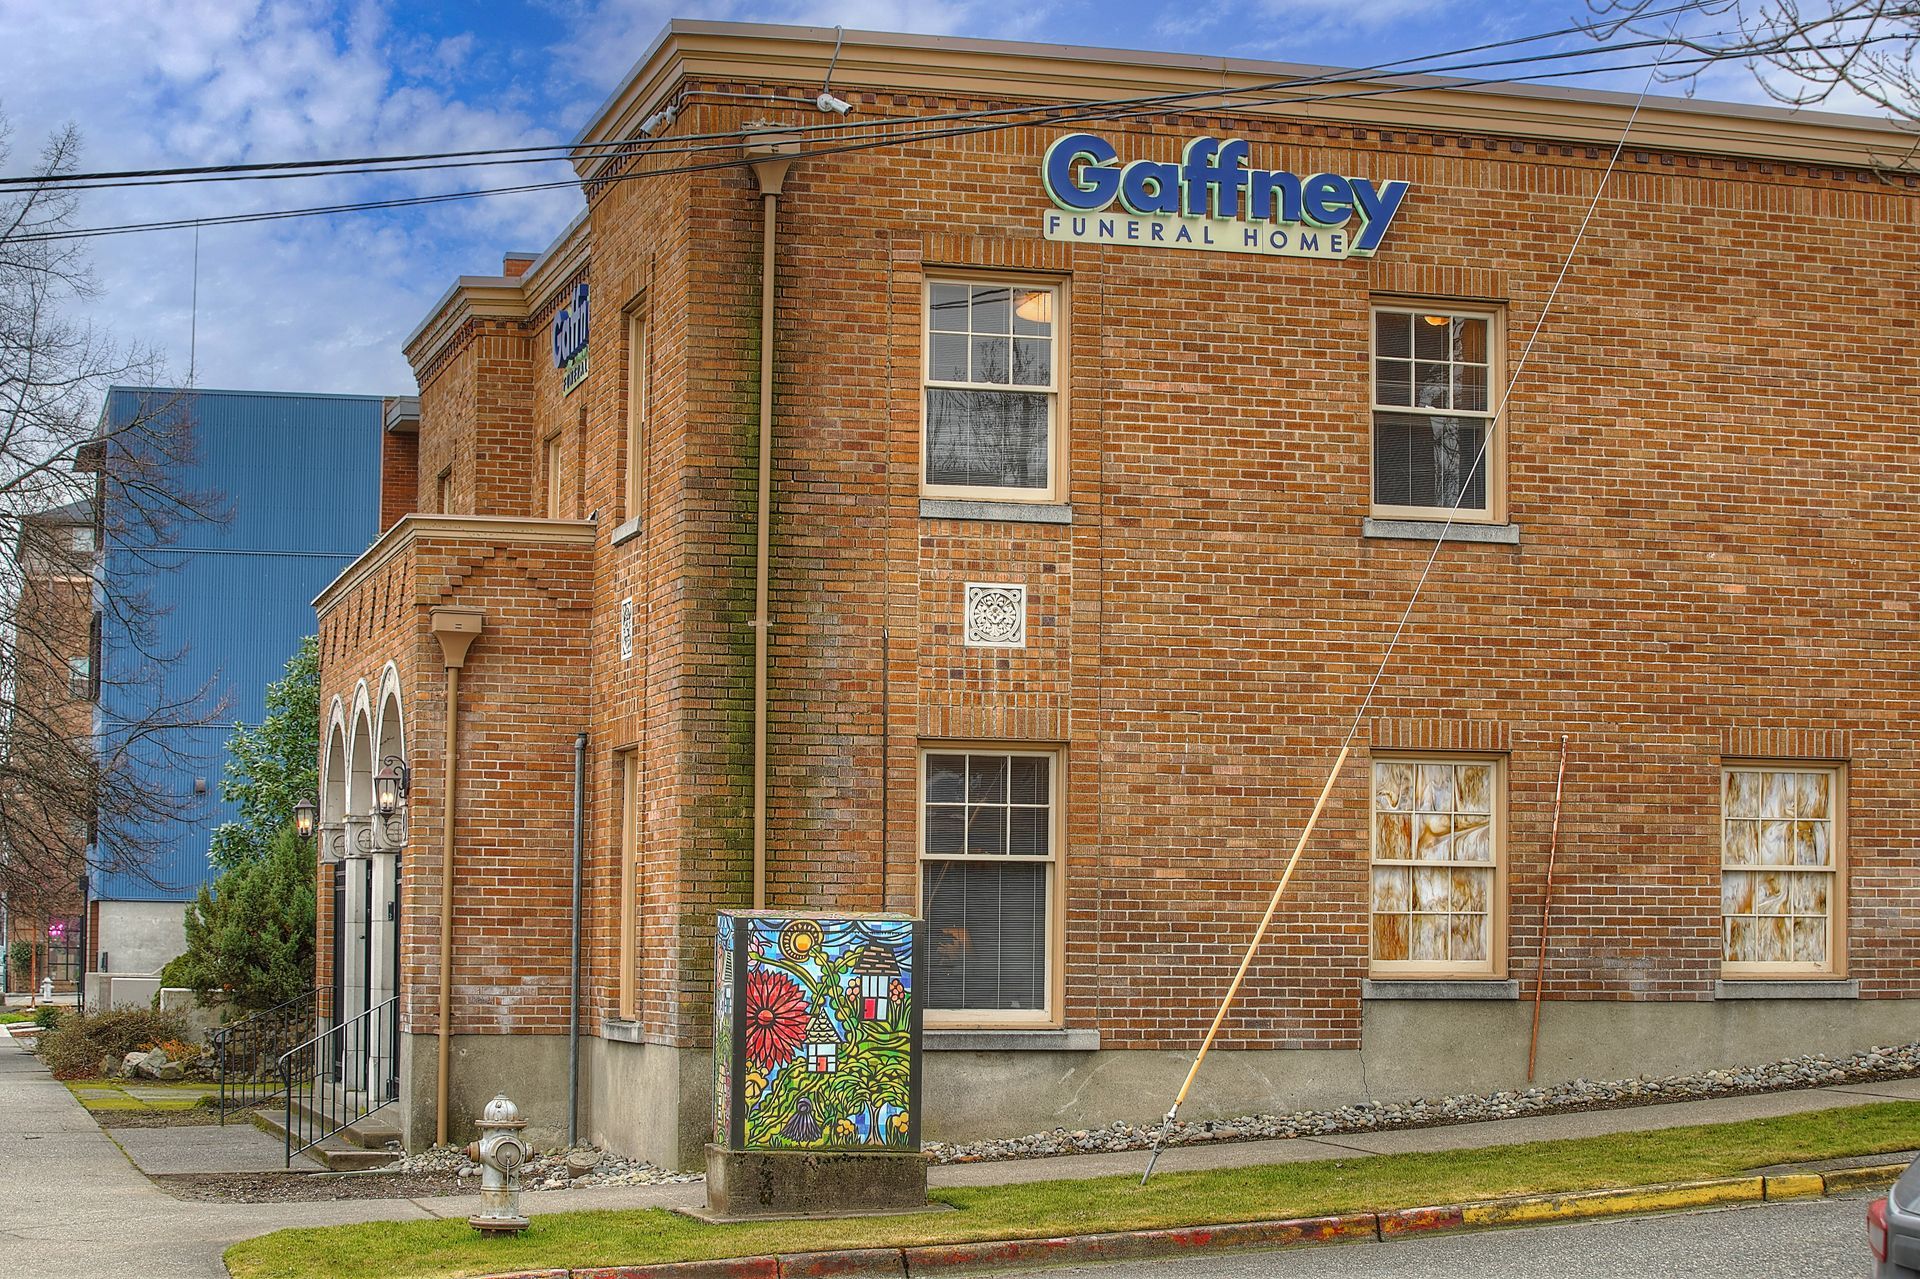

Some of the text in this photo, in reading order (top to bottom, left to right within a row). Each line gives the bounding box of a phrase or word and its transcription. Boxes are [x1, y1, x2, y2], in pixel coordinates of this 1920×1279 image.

[1042, 133, 1409, 254] Gaffney
[1048, 215, 1343, 253] FUNERAL HOME
[552, 283, 589, 368] Gaffn
[563, 357, 588, 391] FUNERAL
